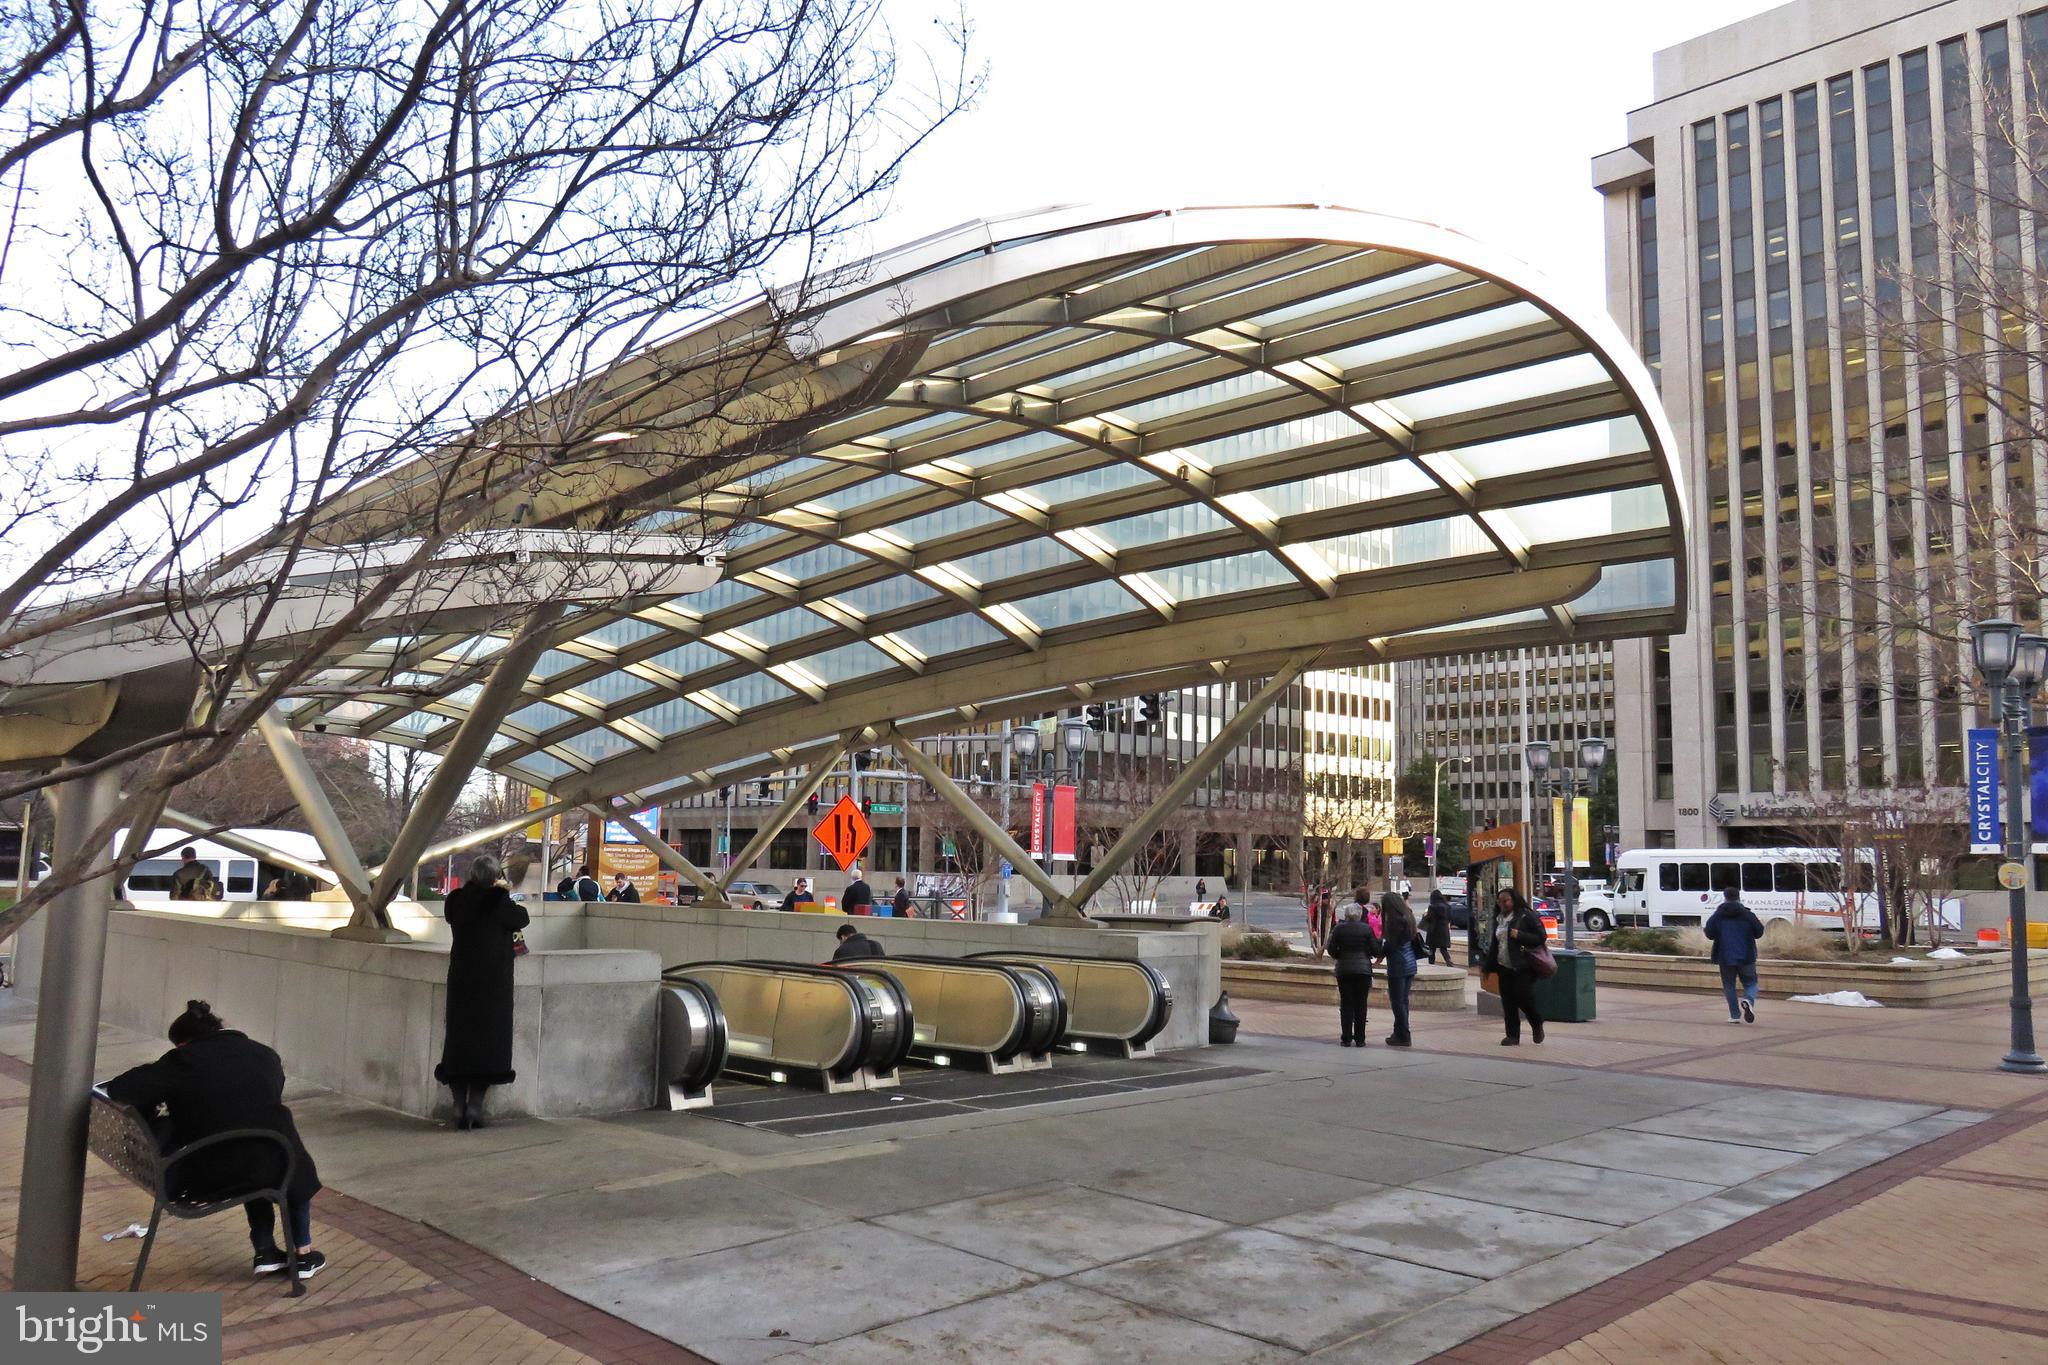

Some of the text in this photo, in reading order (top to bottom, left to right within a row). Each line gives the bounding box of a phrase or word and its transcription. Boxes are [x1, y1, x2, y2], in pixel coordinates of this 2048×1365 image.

[1976, 742, 1991, 842] CRYSTALCITY
[1678, 808, 1699, 817] 1800
[1740, 804, 1812, 818] University
[1034, 791, 1042, 852] CRYSTALCITY
[1472, 837, 1517, 850] CrystalCity
